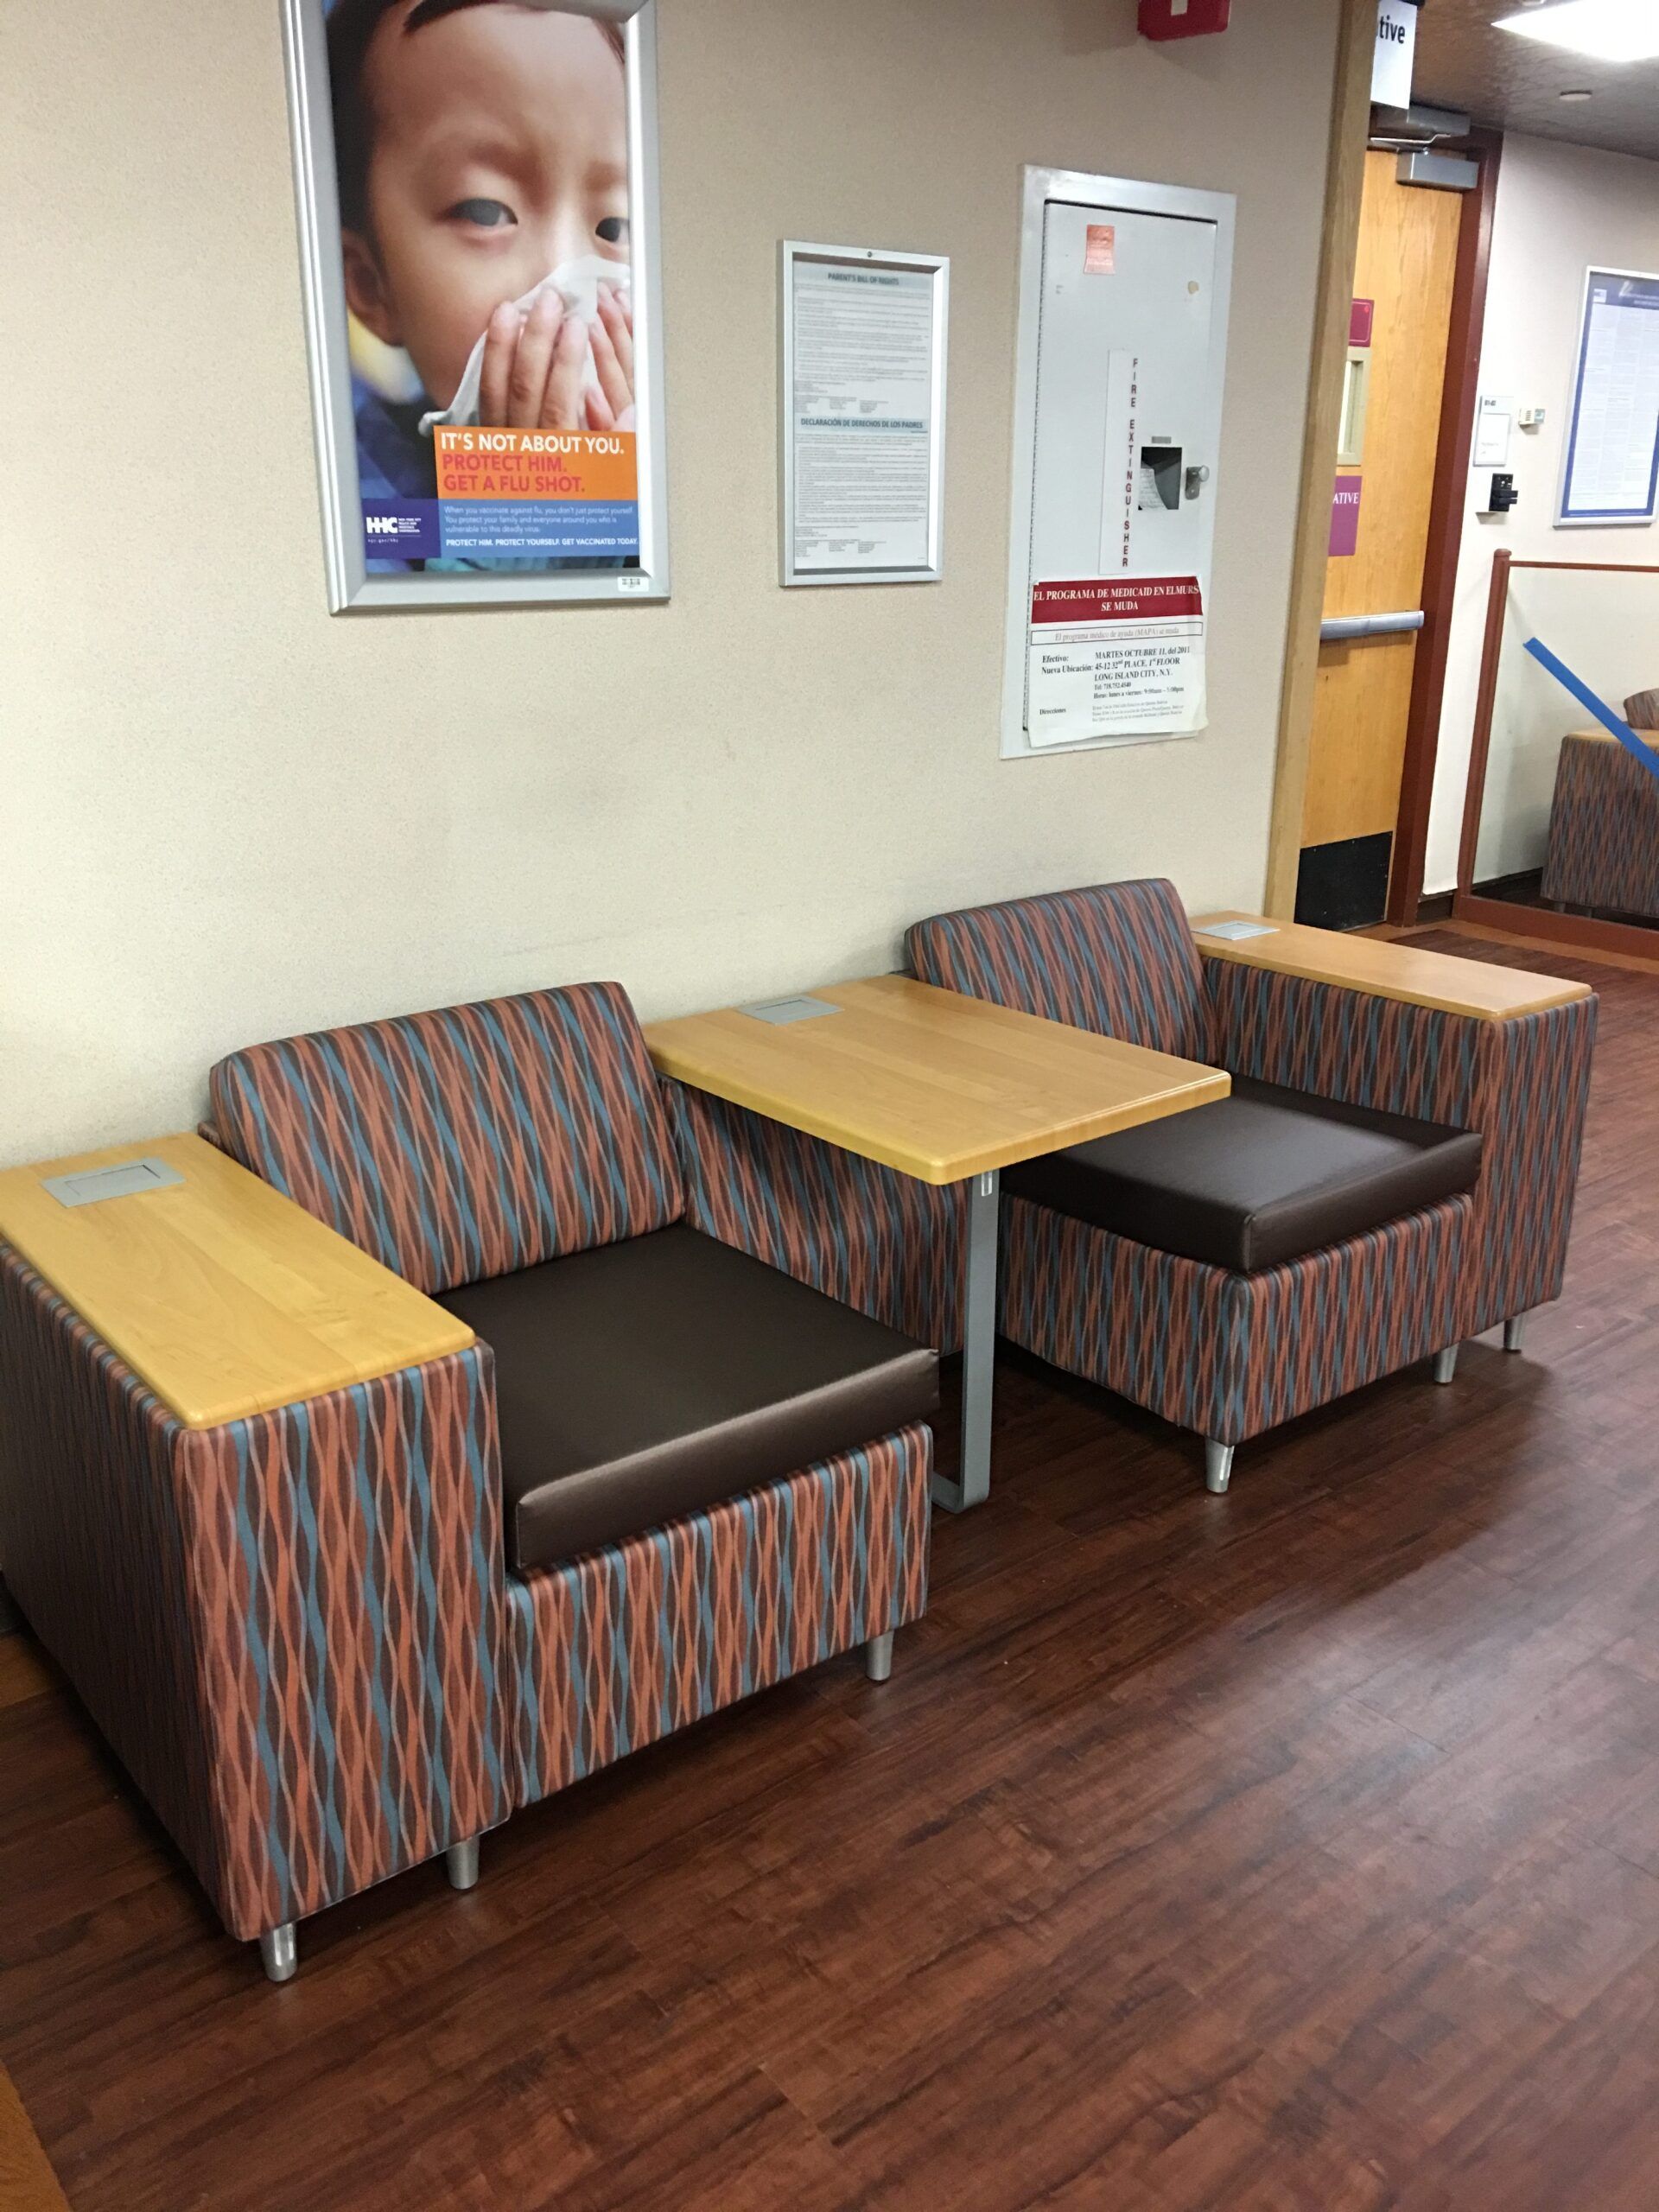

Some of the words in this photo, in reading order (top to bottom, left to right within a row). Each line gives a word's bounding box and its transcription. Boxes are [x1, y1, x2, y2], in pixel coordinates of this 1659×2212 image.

[1379, 14, 1406, 44] tive
[828, 272, 856, 282] PARENT'S
[857, 275, 868, 283] BILL
[879, 276, 899, 285] RIGHTS
[1130, 358, 1139, 408] FIRE
[801, 417, 842, 427] DECLARACIÓN
[441, 432, 474, 450] IT'S
[478, 434, 518, 452] NOT
[519, 435, 582, 454] ABOUT
[584, 436, 625, 454] YOU.
[442, 454, 524, 471] PROTECT
[528, 455, 568, 473] HIM.
[443, 474, 479, 492] GET
[482, 475, 495, 492] A
[499, 475, 530, 493] FLU
[535, 475, 586, 493] SHOT.
[1122, 419, 1135, 567] EXTINGUISHER
[1332, 492, 1359, 505] ATIVE
[443, 505, 464, 514] When
[465, 507, 478, 517] you
[510, 506, 532, 516] against
[544, 507, 556, 516] you
[575, 506, 587, 516] just
[588, 506, 609, 516] protect
[365, 516, 398, 534] HHC
[444, 515, 457, 524] You
[458, 516, 482, 525] protect
[499, 515, 518, 524] family
[444, 524, 480, 533] vulnerable
[489, 524, 501, 533] this
[502, 524, 524, 534] deadly
[562, 537, 575, 546] GET
[1033, 591, 1045, 601] EL
[1046, 588, 1096, 601] PROGRAMA
[1096, 588, 1109, 599] DE
[1110, 586, 1153, 598] MEDICAID
[1154, 586, 1165, 596] EN
[1101, 601, 1112, 612] SE
[1113, 601, 1139, 611] MUDA
[1055, 632, 1062, 641] El
[1062, 632, 1089, 643] programa
[1109, 630, 1117, 639] de
[1117, 630, 1134, 639] ayuda
[1042, 654, 1070, 664] Efectivo:
[1095, 649, 1123, 659] MARTES
[1124, 647, 1158, 658] OCTUBRE
[1167, 646, 1177, 655] del
[1041, 665, 1061, 674] Nueva
[1061, 664, 1094, 673] Ubicación:
[1095, 661, 1110, 671] 45-12
[1156, 656, 1180, 666] FLOOR
[1094, 673, 1114, 683] LONG
[1115, 671, 1140, 680] ISLAND
